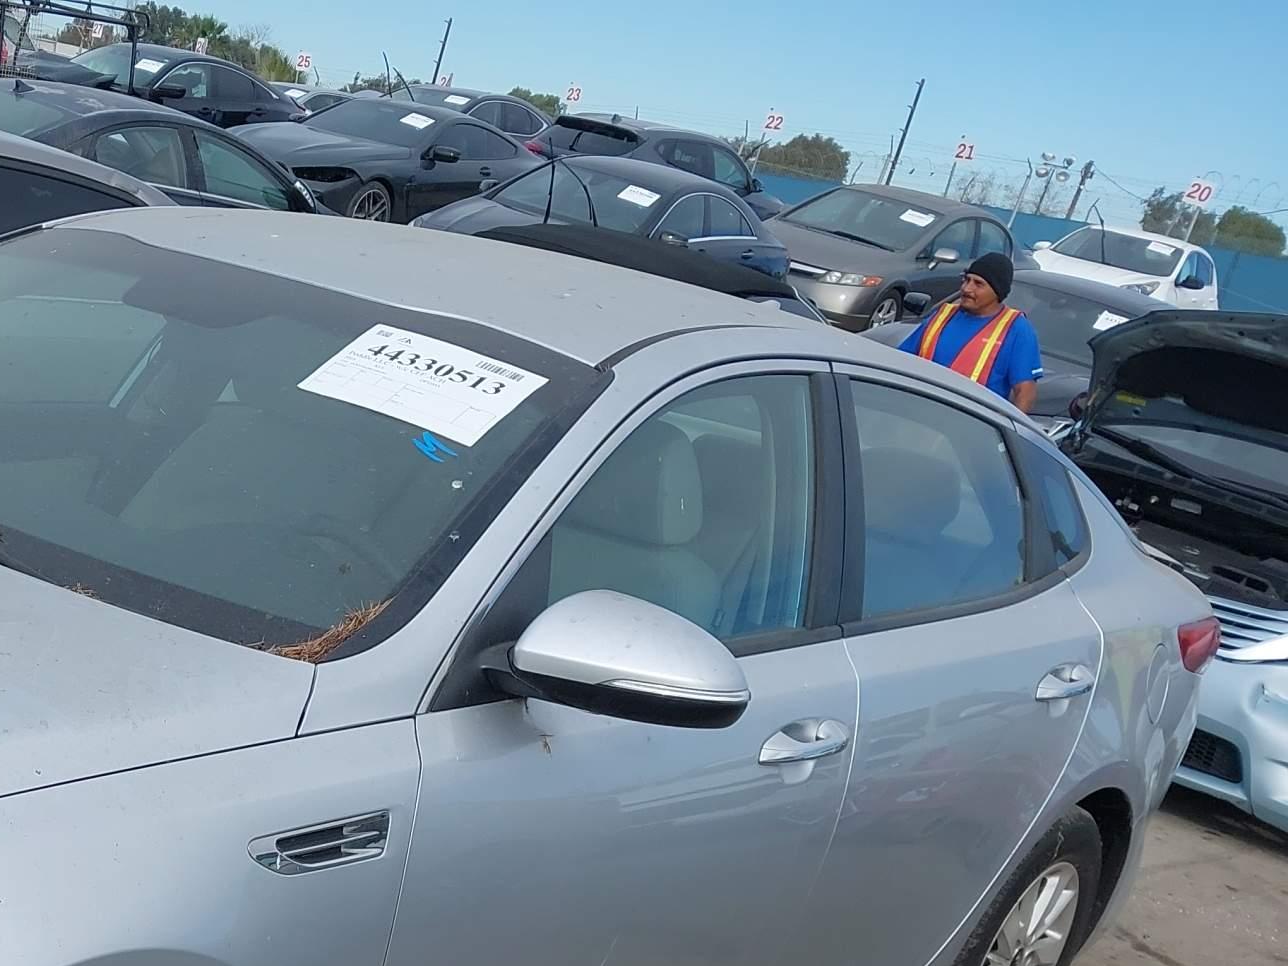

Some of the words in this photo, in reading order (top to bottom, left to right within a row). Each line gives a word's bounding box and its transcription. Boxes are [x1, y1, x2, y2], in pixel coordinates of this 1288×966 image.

[93, 23, 103, 35] 27
[297, 55, 311, 68] 25
[567, 87, 581, 101] 23
[765, 115, 783, 130] 22
[955, 143, 974, 160] 21
[1186, 183, 1212, 202] 20
[367, 344, 507, 396] 44330513
